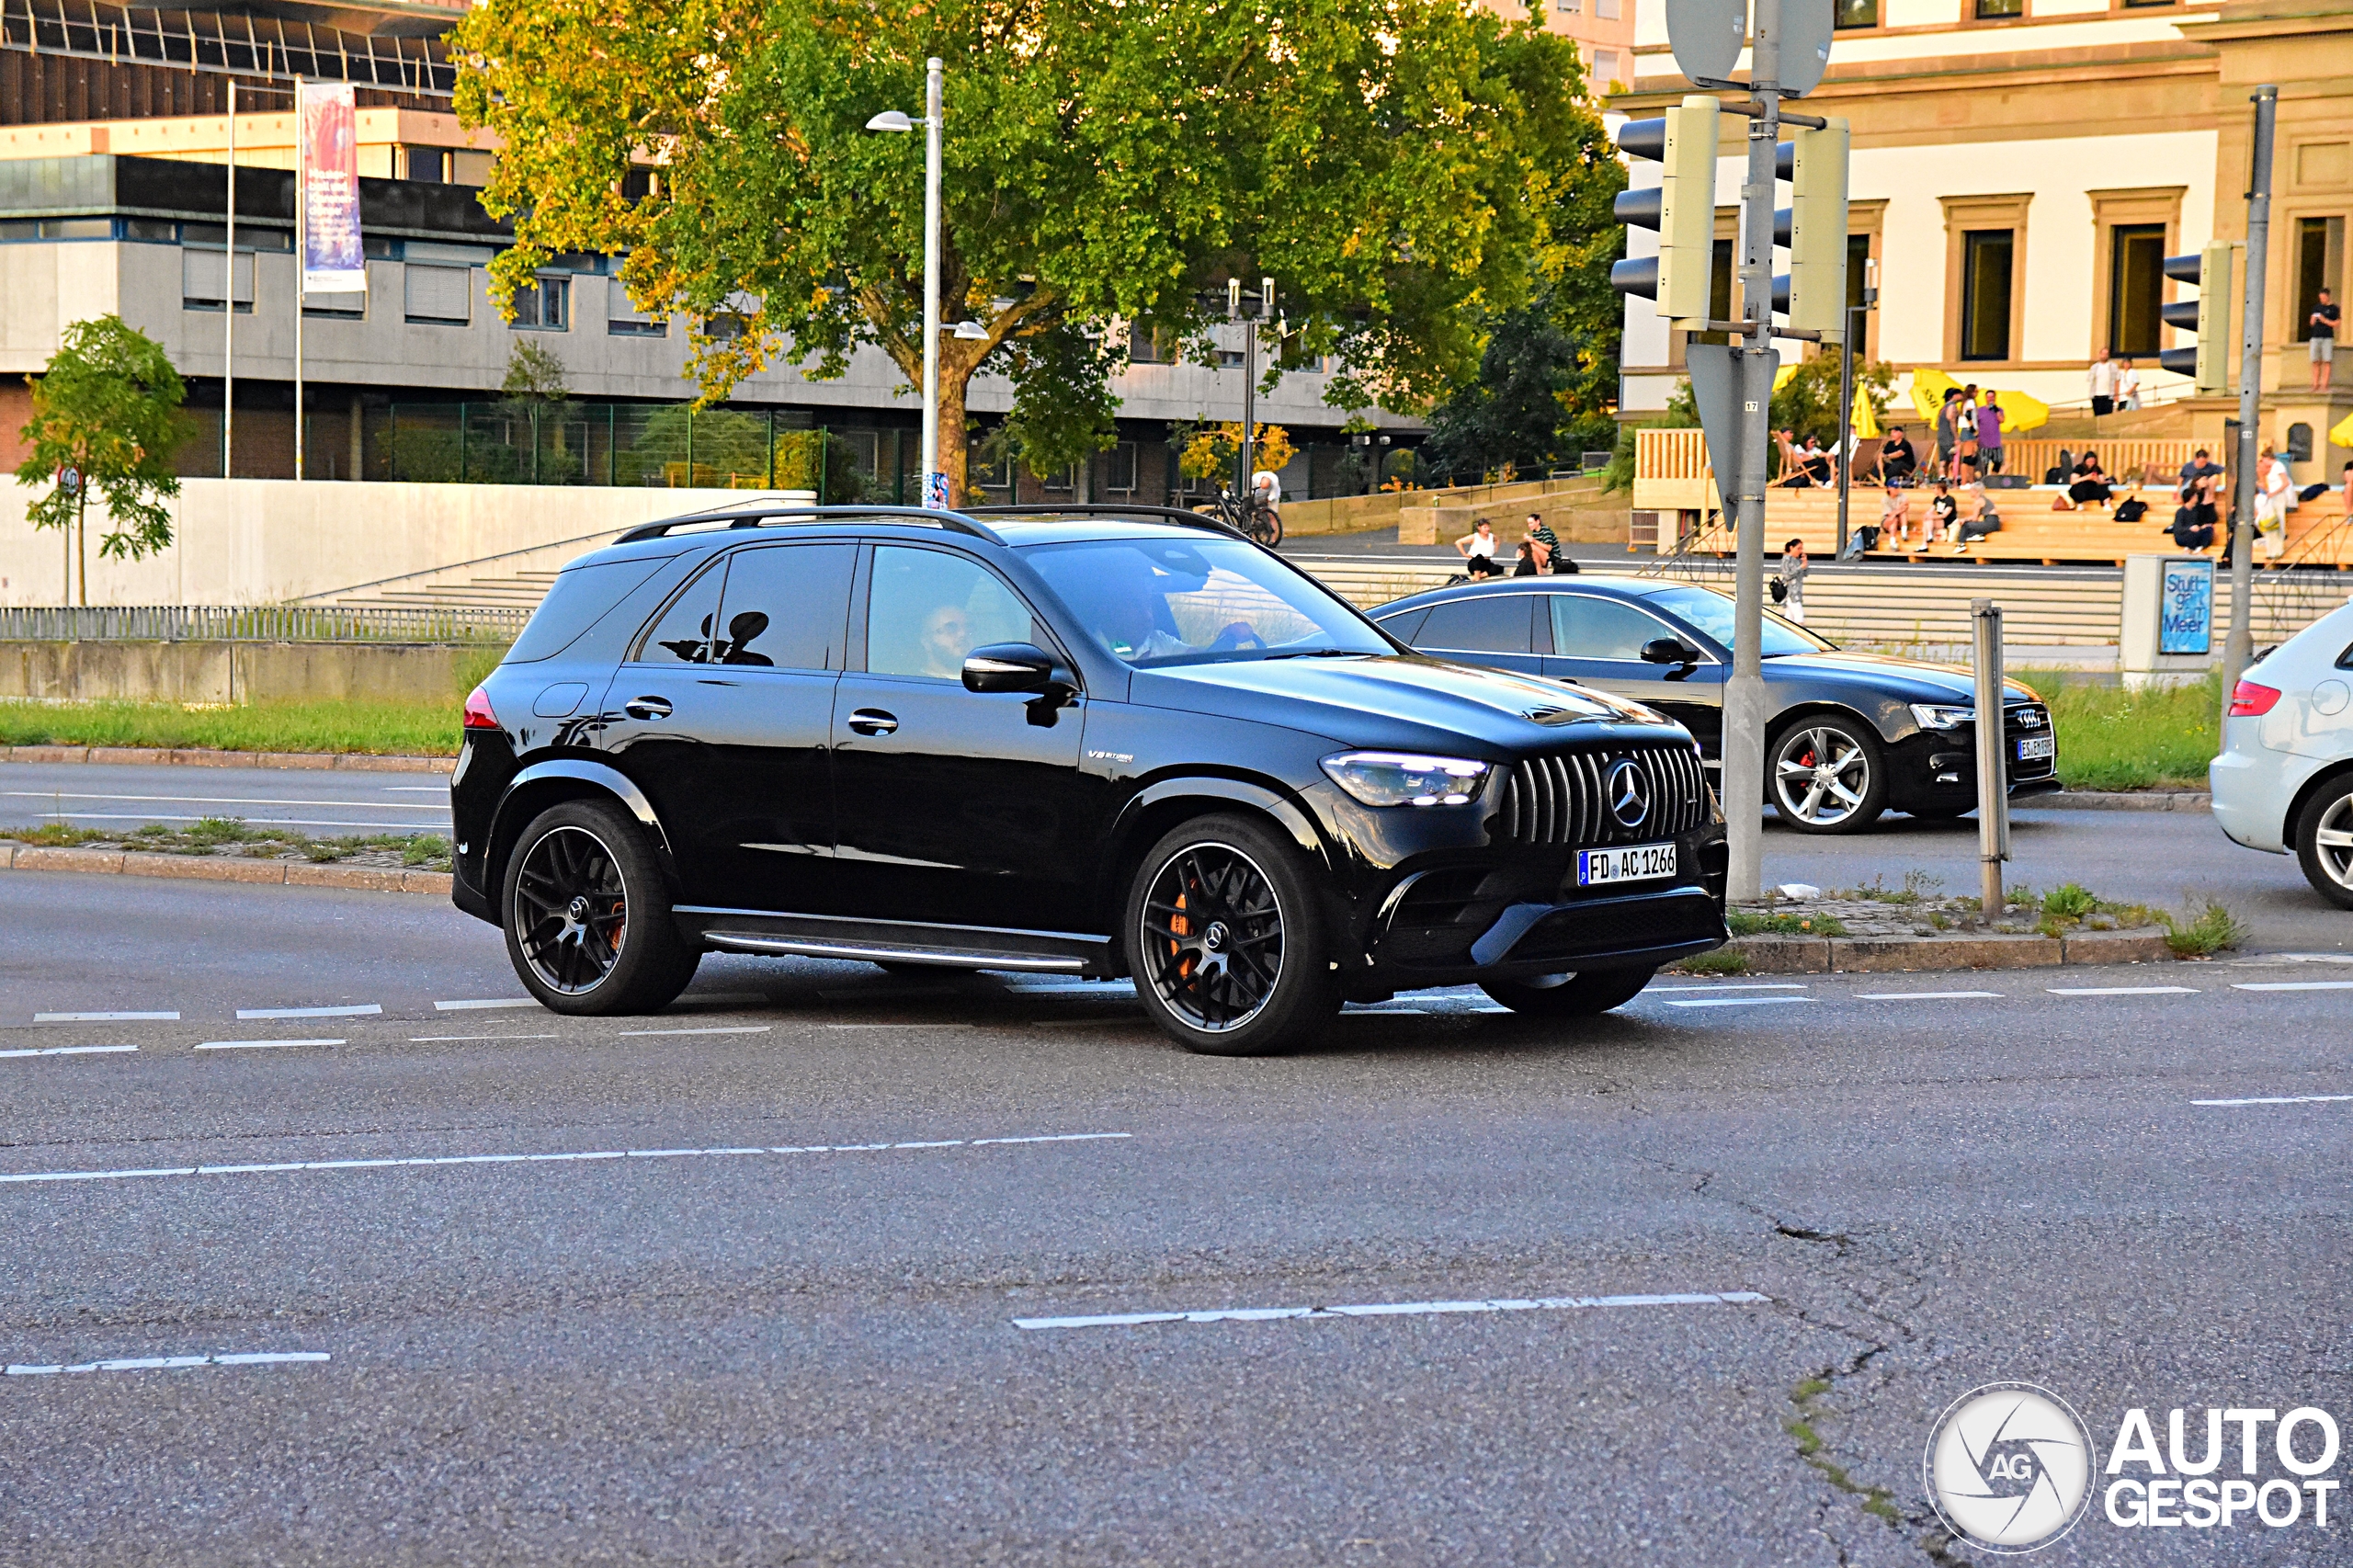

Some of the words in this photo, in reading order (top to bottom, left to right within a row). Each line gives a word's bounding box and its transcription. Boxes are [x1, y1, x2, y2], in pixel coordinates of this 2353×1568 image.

[2164, 614, 2204, 632] Meer
[1088, 750, 1106, 759] V8
[2022, 741, 2030, 756] ES
[1590, 854, 1609, 880] FD
[1621, 851, 1638, 877] AC
[1643, 846, 1675, 874] 1266
